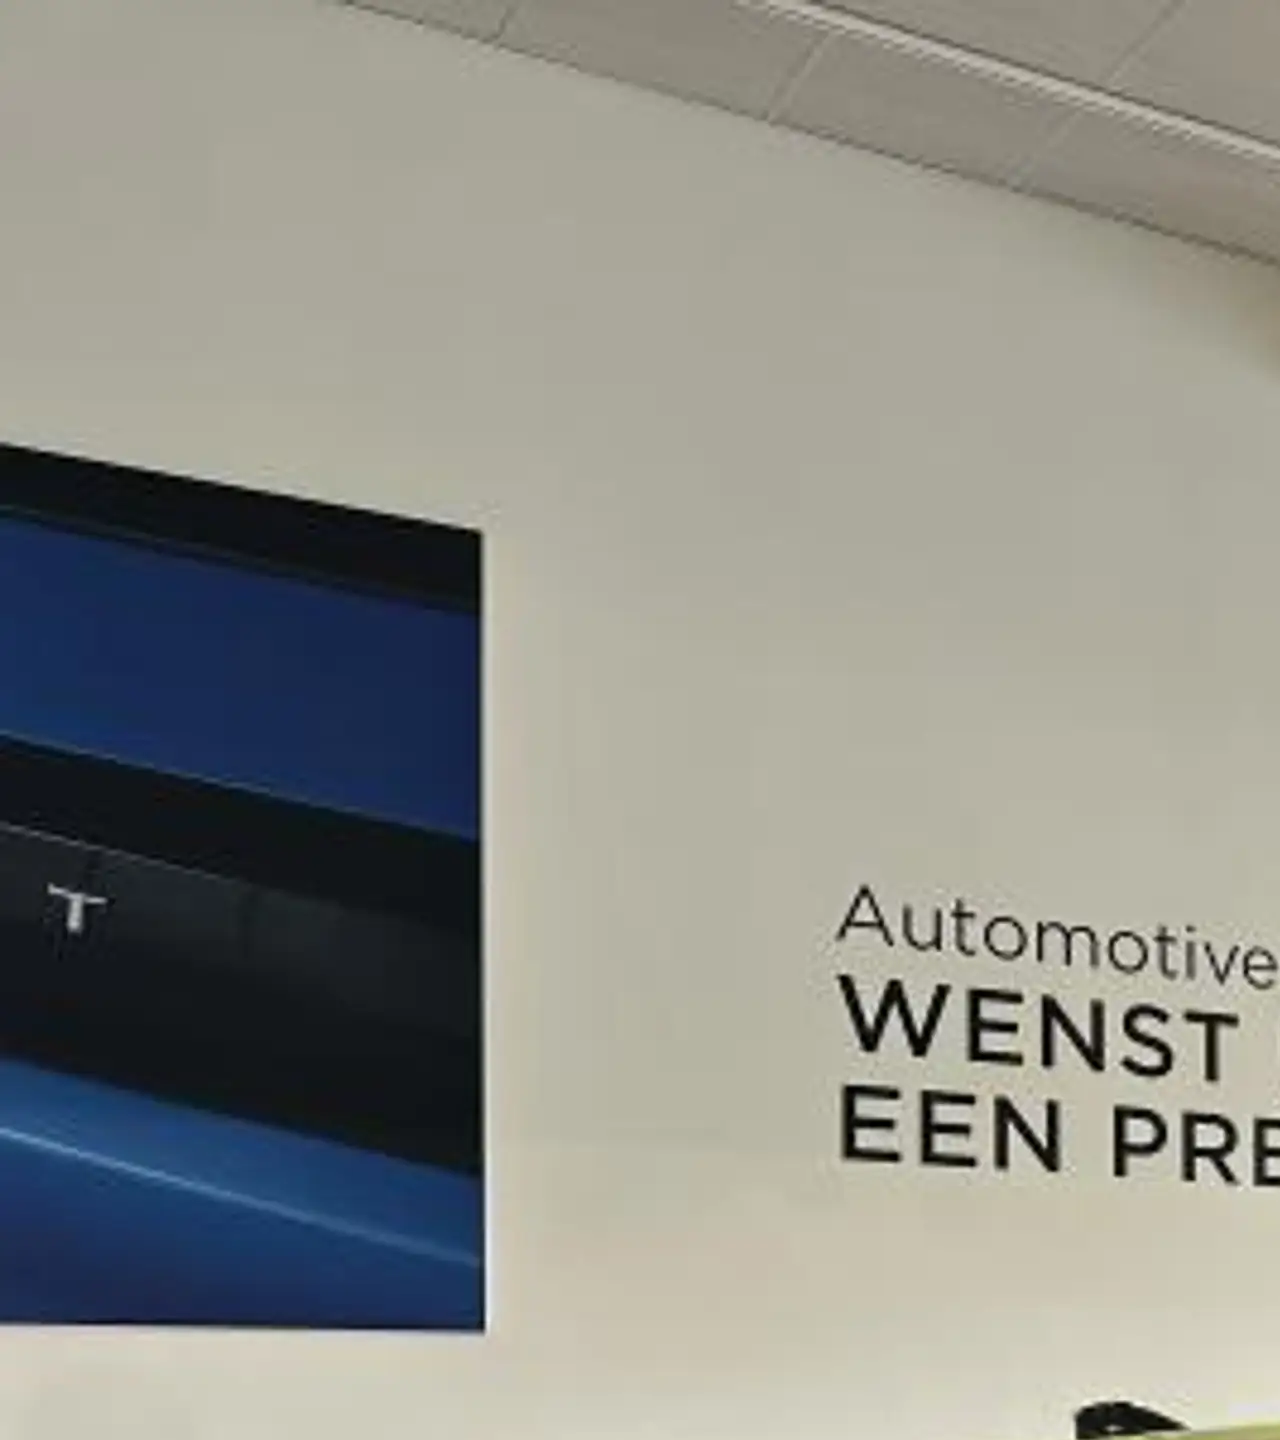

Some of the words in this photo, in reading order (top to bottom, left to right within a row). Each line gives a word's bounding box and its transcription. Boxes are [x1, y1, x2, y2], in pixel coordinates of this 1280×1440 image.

[47, 882, 108, 934] T
[833, 881, 1280, 993] Automotive
[838, 970, 1243, 1086] WENST
[838, 1081, 1064, 1176] EEN
